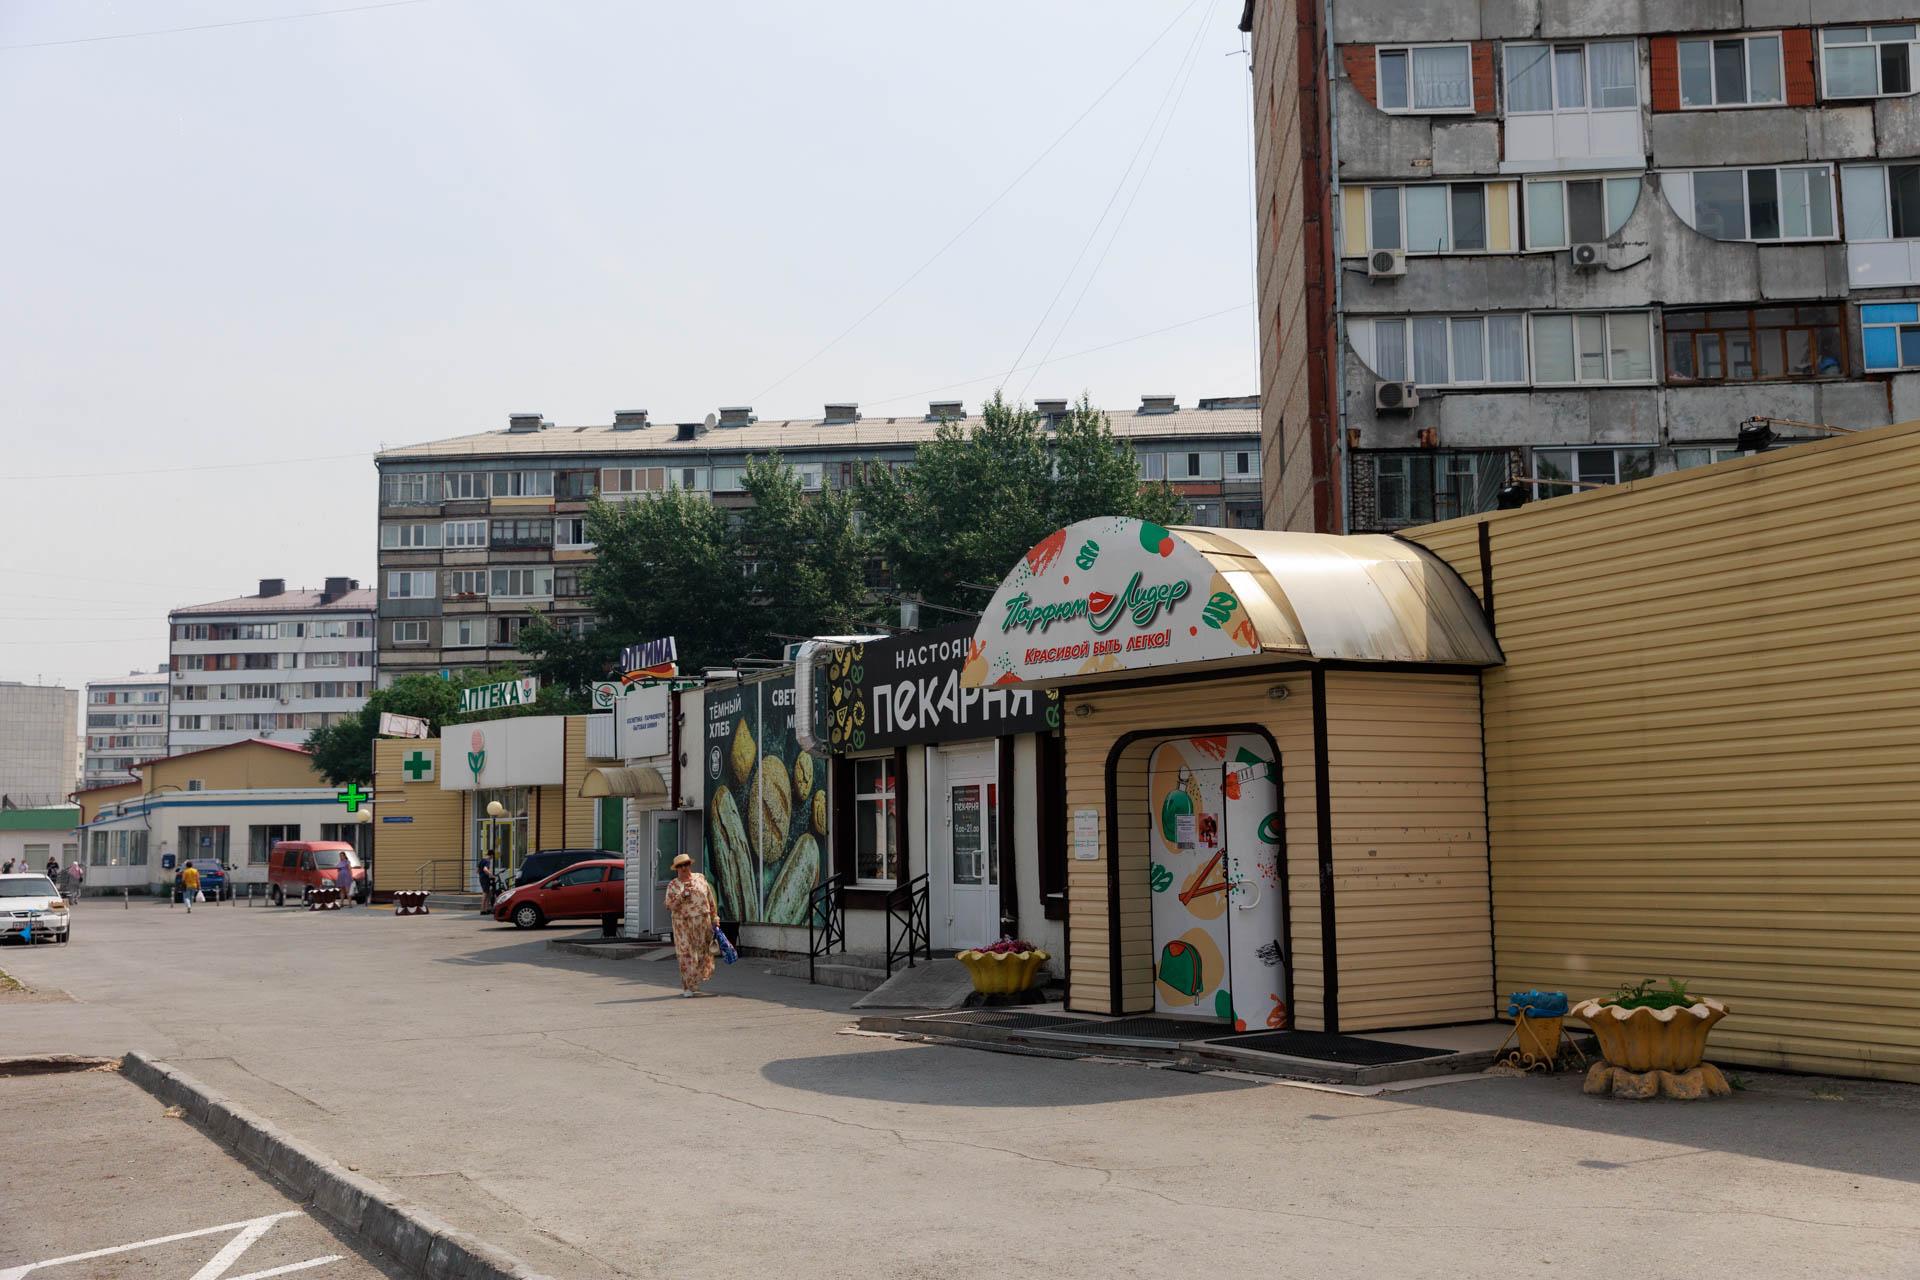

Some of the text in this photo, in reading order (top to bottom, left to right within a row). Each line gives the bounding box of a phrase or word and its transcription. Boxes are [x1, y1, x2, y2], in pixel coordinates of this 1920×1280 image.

[1002, 569, 1188, 632] Парфюм Лидер
[620, 637, 674, 672] ОПТИМА
[1024, 628, 1171, 665] КРАСИВОЙ БЫТЬ ЛЕГКО!
[458, 680, 521, 712] АПТЕКА
[709, 694, 742, 720] ТЁМНЫЙ
[709, 720, 730, 738] ХЛЕБ
